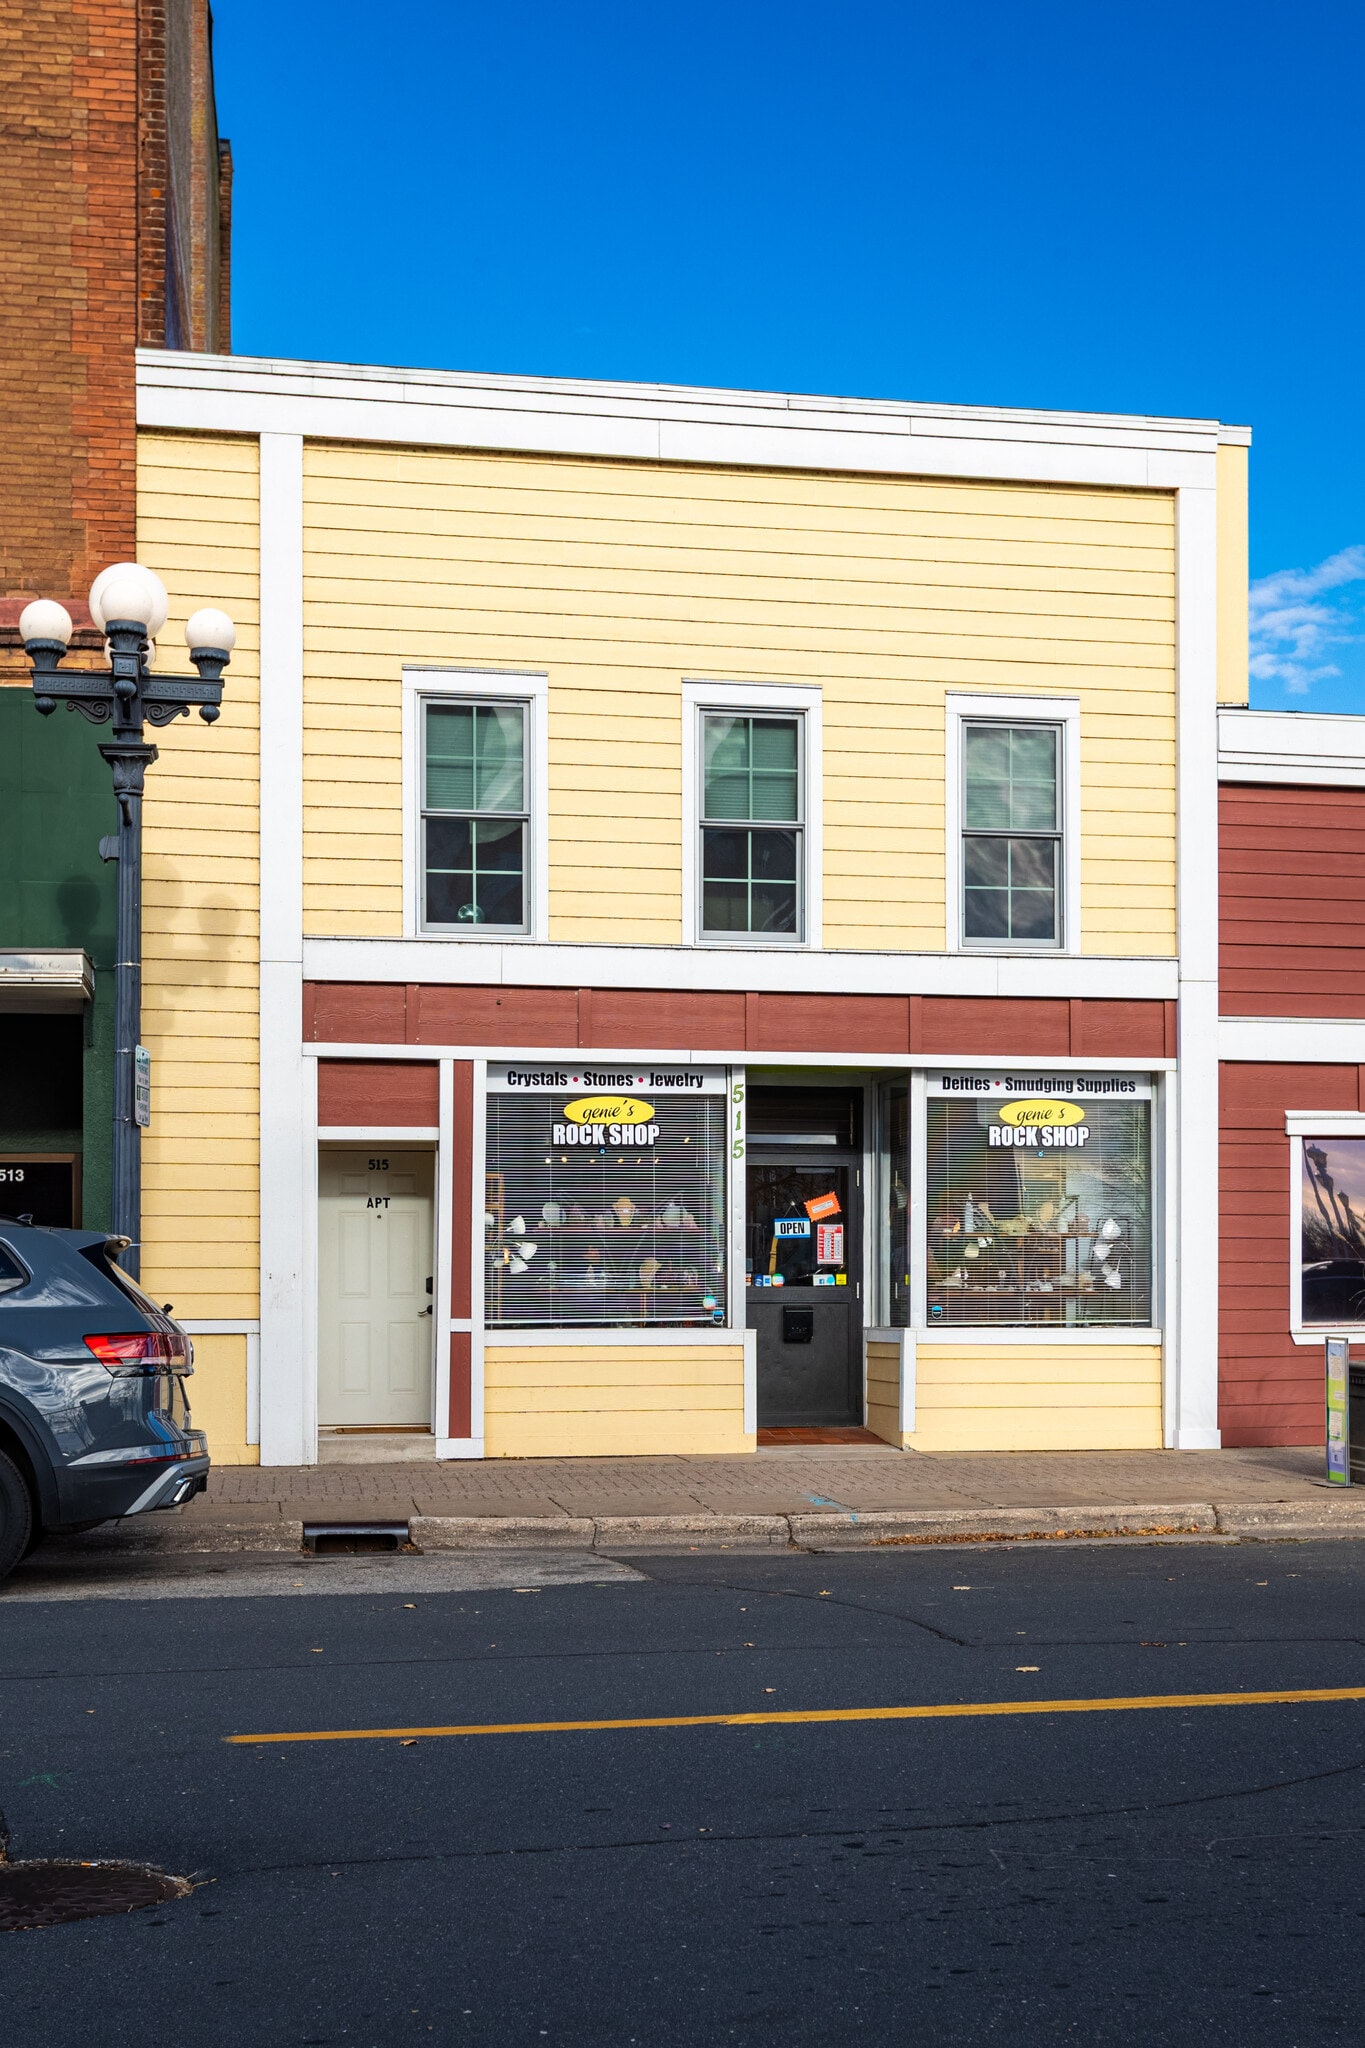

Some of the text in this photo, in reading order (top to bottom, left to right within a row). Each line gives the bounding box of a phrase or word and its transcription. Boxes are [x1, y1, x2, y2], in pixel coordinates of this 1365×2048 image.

[507, 1070, 704, 1089] Crystals Stones Jewelry
[942, 1076, 1136, 1094] Deities Smudging Supplies
[577, 1100, 635, 1127] genie's
[553, 1124, 660, 1146] ROCK SHOP
[988, 1126, 1090, 1147] ROCK SHOP
[368, 1159, 389, 1171] 515
[0, 1169, 25, 1182] 513
[366, 1197, 391, 1209] APT
[780, 1222, 805, 1235] OPEN
